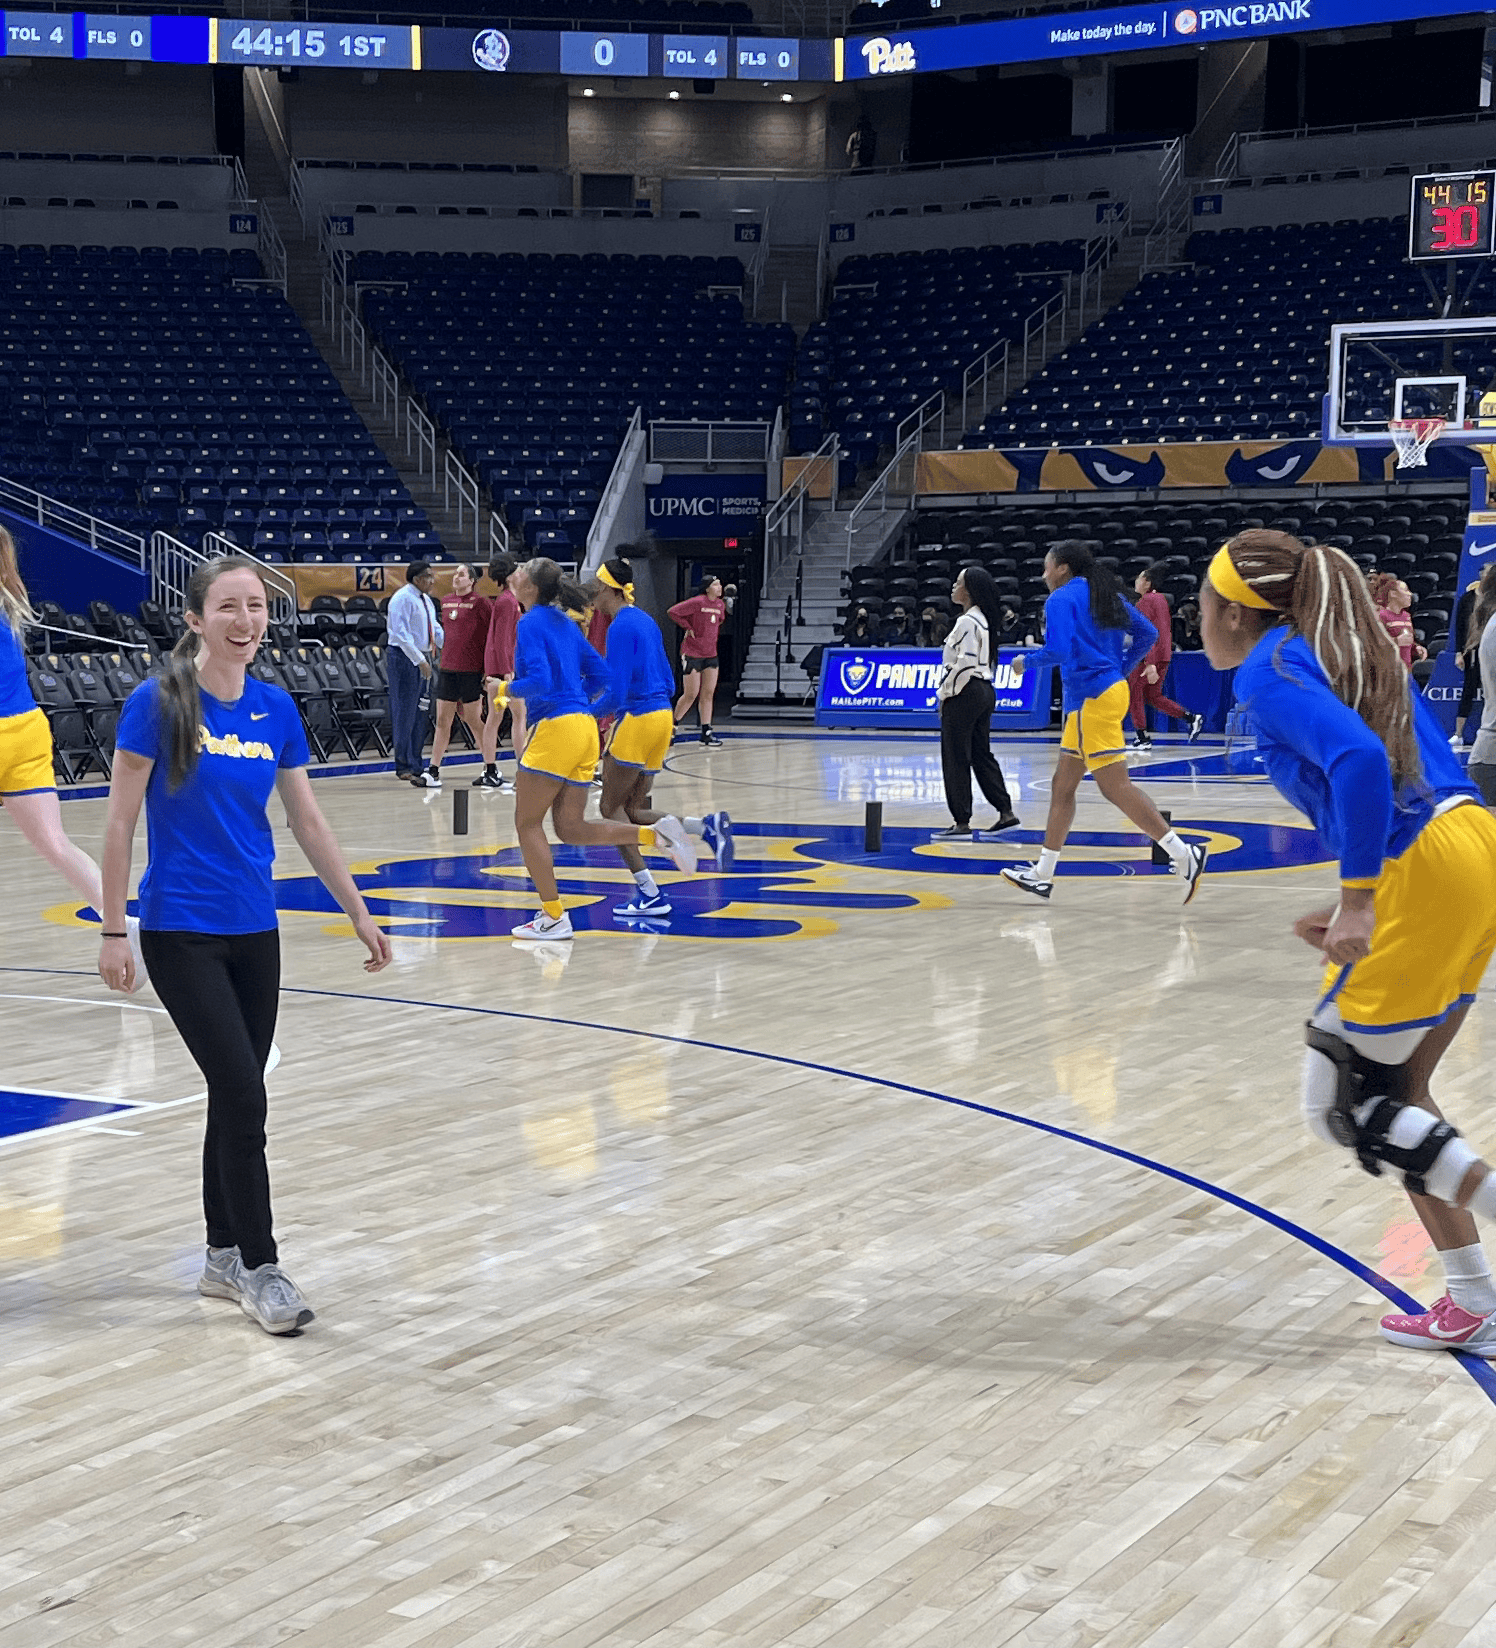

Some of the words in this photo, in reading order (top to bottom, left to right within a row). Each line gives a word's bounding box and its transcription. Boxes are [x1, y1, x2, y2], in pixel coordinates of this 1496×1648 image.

[8, 26, 41, 41] TOL
[49, 26, 64, 44] 4
[87, 29, 117, 44] FLS
[129, 29, 144, 48] 0
[231, 27, 326, 58] 44:15
[339, 35, 387, 57] 1ST
[1050, 29, 1081, 43] Make
[1081, 25, 1113, 41] today
[1114, 22, 1133, 36] the
[1134, 20, 1157, 36] day.
[594, 38, 614, 66] 0
[666, 49, 697, 64] TOL
[704, 48, 718, 66] 4
[739, 51, 767, 65] FLS
[777, 51, 791, 68] 0
[861, 37, 917, 75] Pitt
[1423, 185, 1451, 205] 44
[1466, 180, 1487, 203] 15
[235, 219, 252, 233] 124
[740, 228, 757, 241] 125
[1430, 205, 1479, 251] 30
[648, 497, 716, 517] UPMC
[359, 566, 384, 590] 24
[875, 663, 945, 689] PANTH
